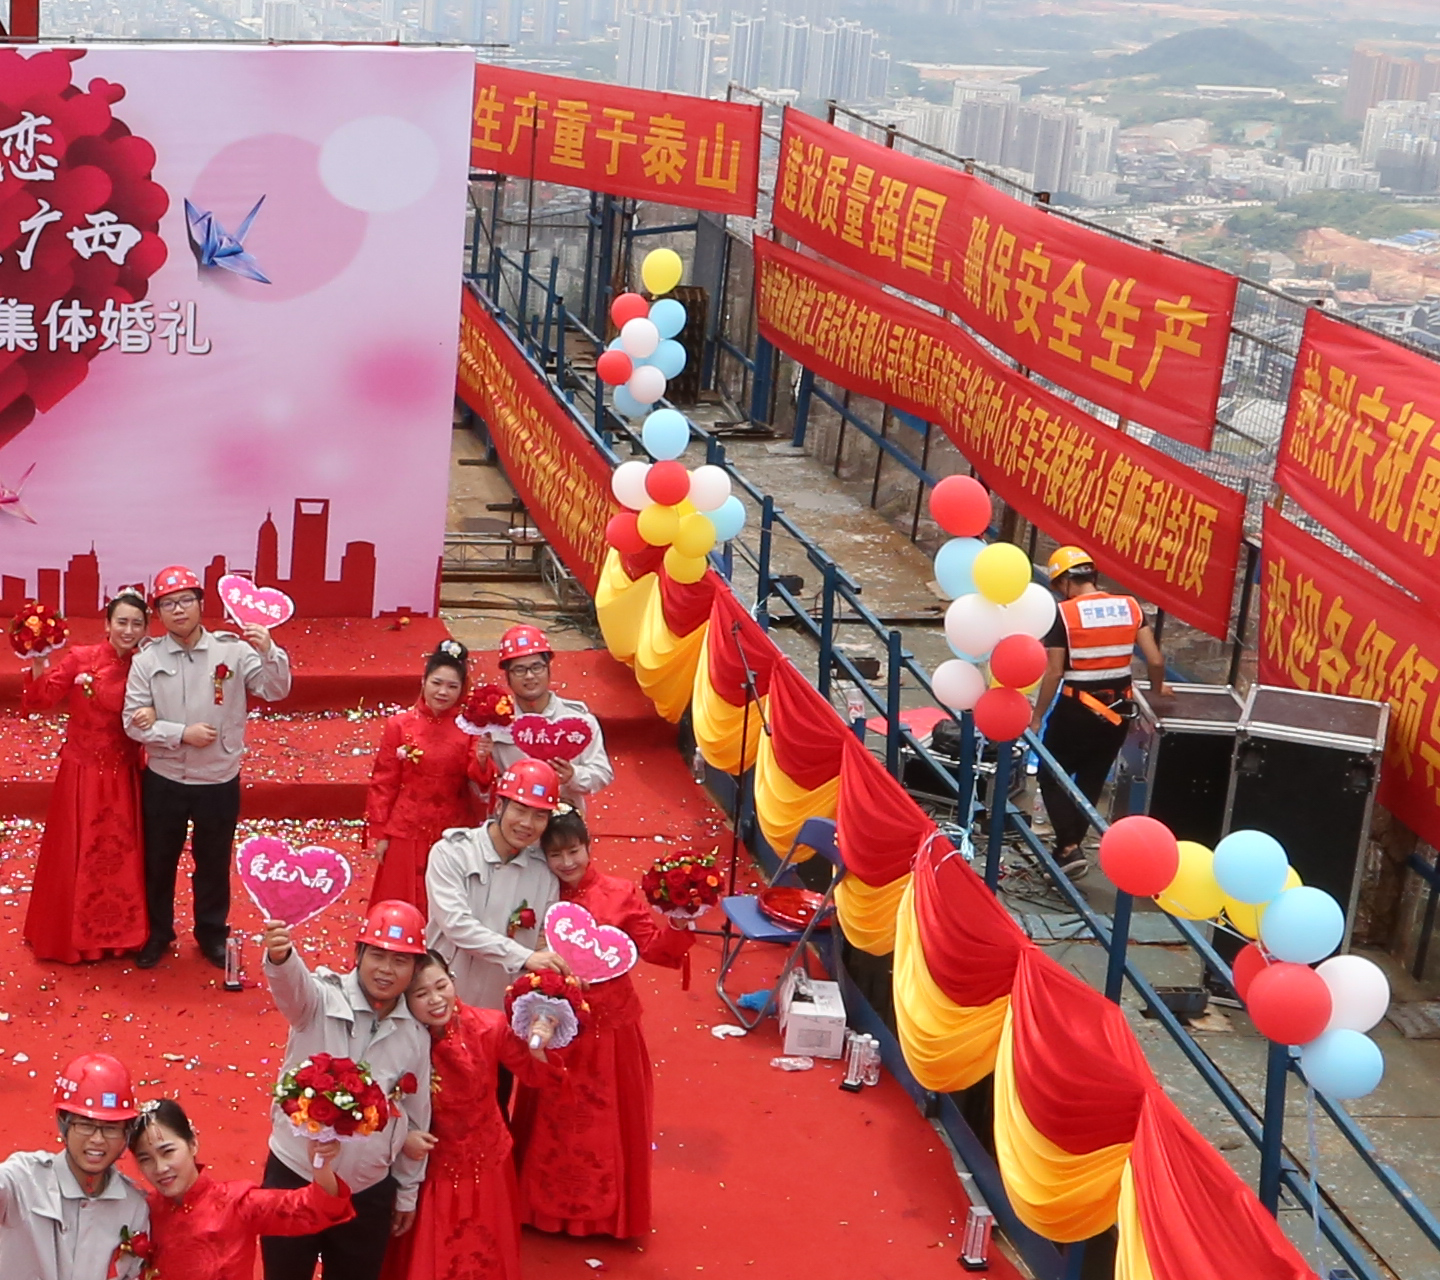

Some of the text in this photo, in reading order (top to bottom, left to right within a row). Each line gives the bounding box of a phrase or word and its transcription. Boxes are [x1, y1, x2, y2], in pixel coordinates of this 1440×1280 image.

[472, 85, 741, 193] 生产重于泰山
[518, 728, 586, 745] 情系广西
[250, 853, 334, 894] 爱在八局
[554, 917, 621, 969] 爱在八局
